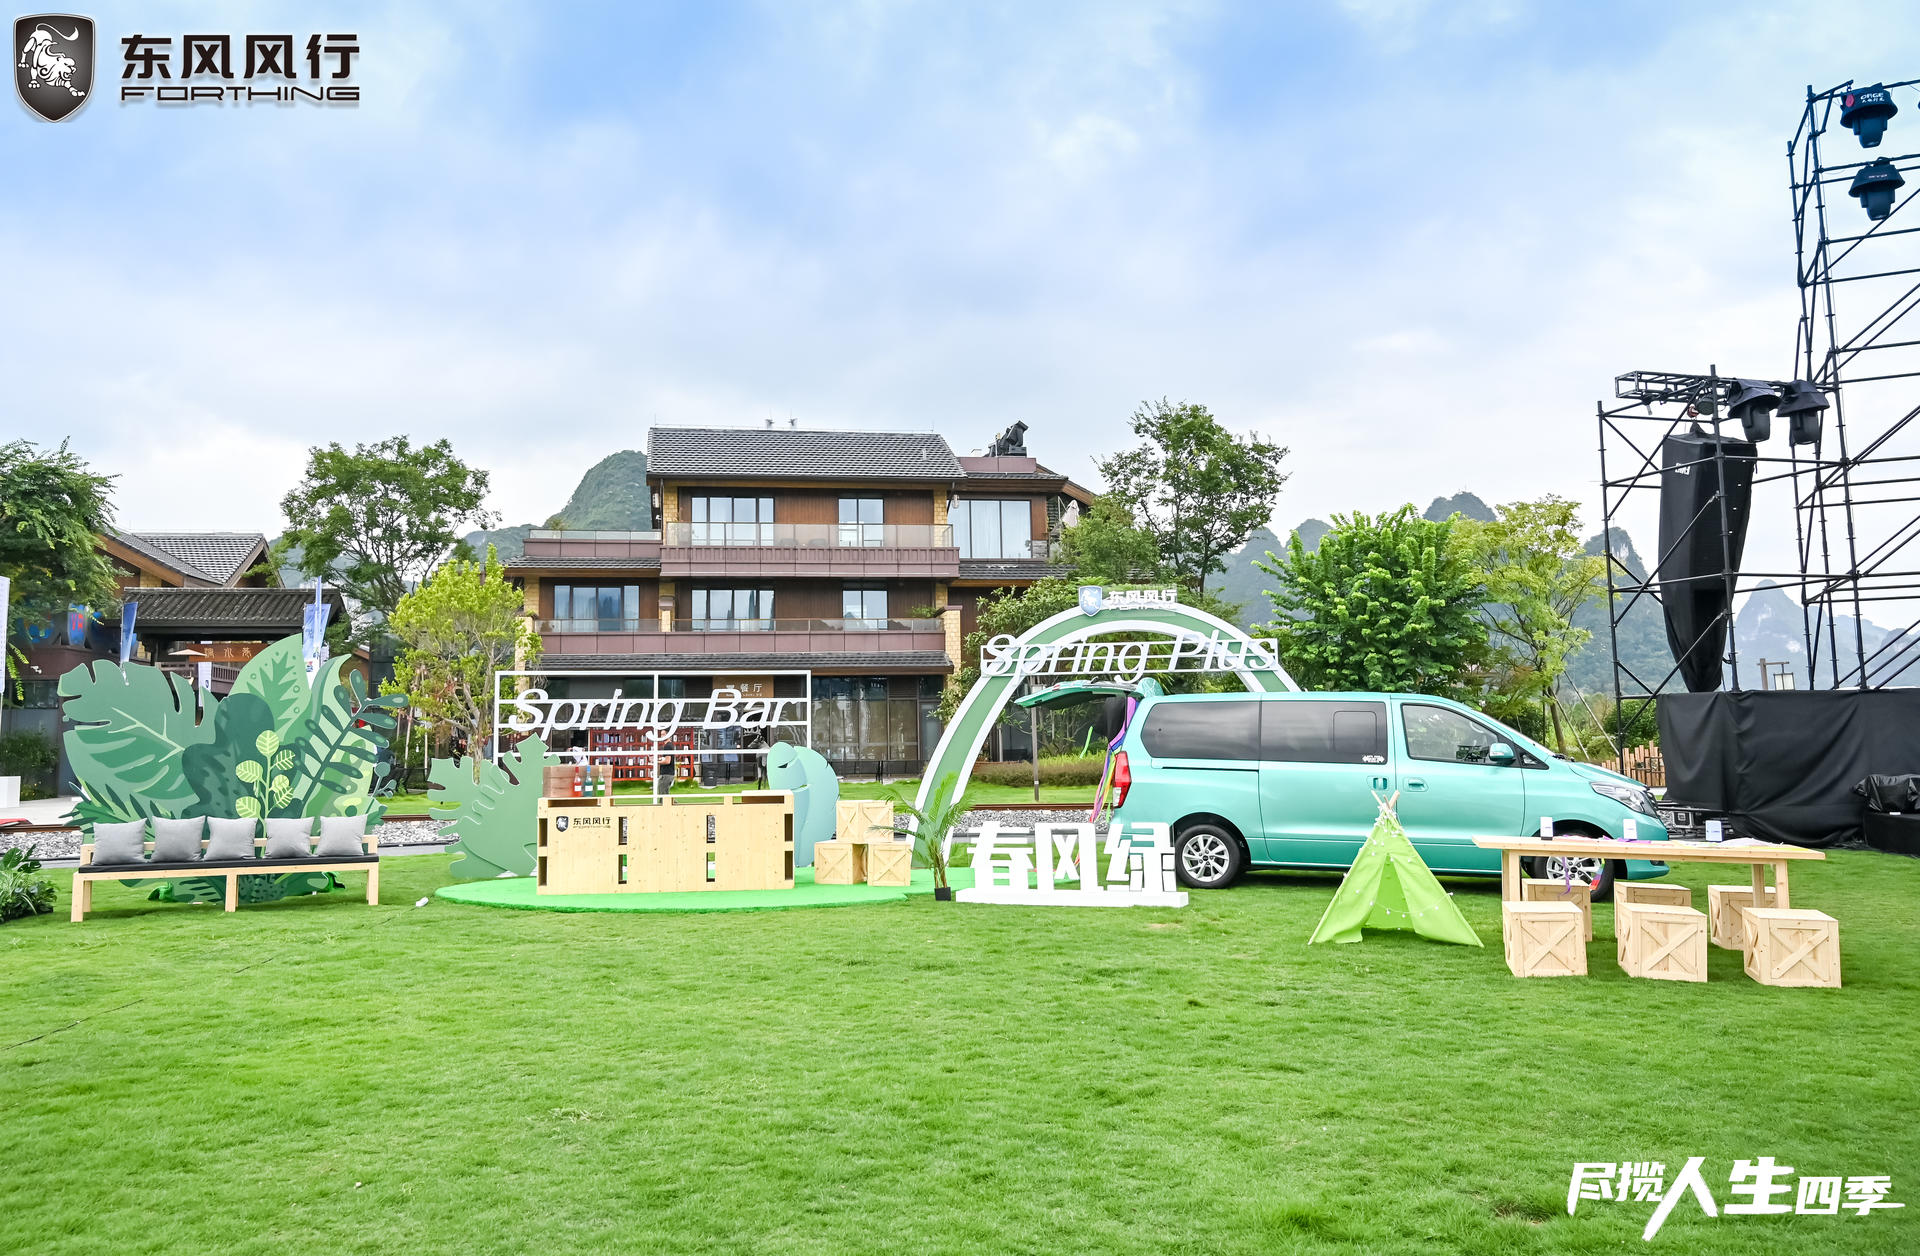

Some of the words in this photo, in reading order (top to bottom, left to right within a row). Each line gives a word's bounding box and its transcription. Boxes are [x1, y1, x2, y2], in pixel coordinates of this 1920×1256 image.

[1108, 589, 1178, 605] 东风风行
[984, 633, 1151, 683] Spring
[1166, 629, 1278, 671] Plus
[508, 688, 689, 742] Spring
[702, 688, 799, 730] Bar
[573, 817, 611, 825] 东风风行
[966, 820, 1177, 892] 春风绿
